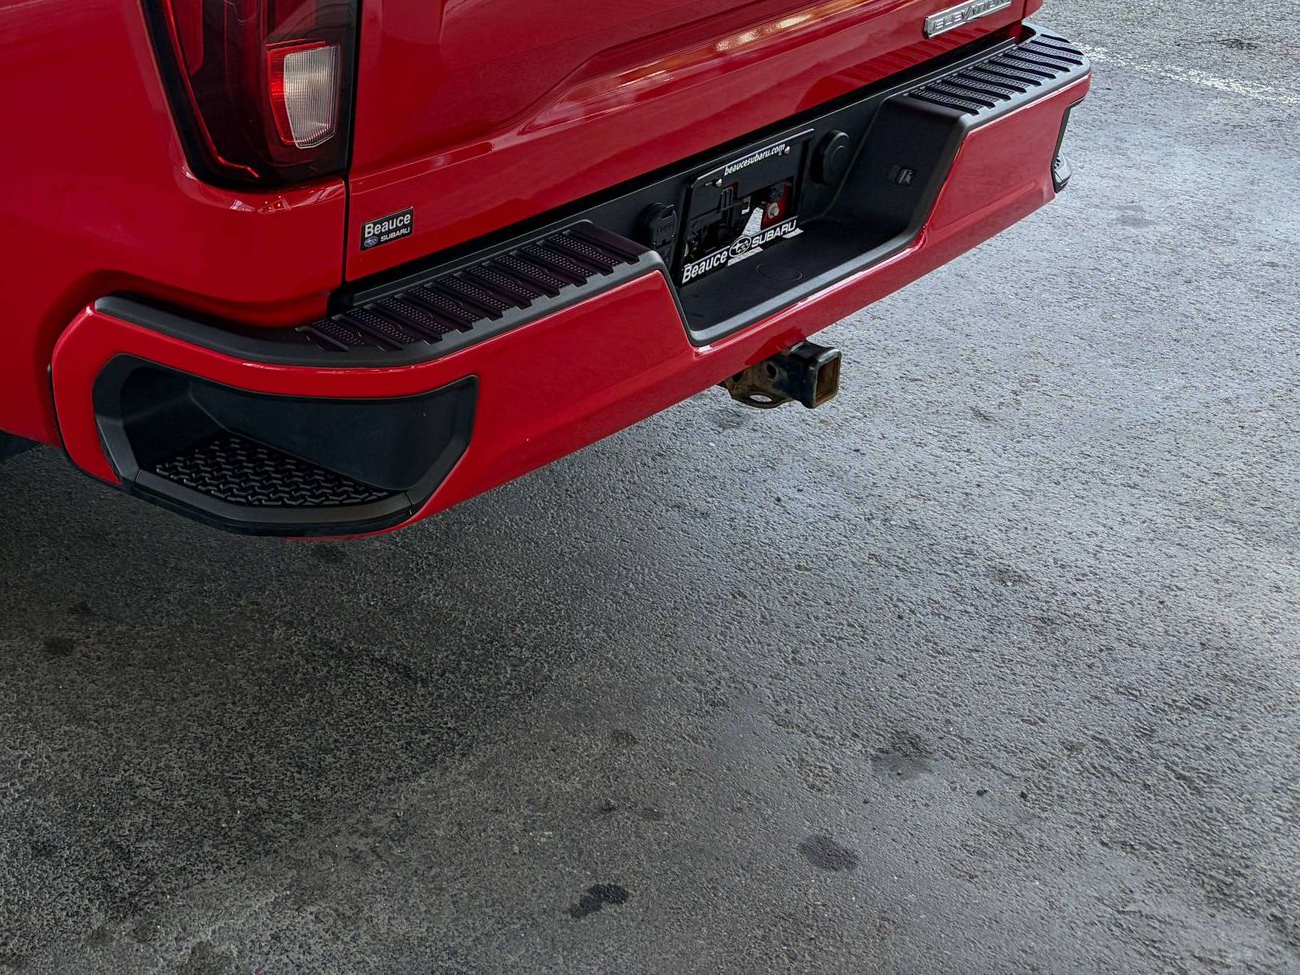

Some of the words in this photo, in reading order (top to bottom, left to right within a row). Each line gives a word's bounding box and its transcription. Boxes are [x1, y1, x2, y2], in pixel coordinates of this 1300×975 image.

[723, 142, 786, 177] beaucesubaru.com
[364, 213, 412, 239] Beauce
[380, 226, 411, 242] SUBARU
[681, 250, 729, 284] Beauce
[751, 220, 798, 248] SUBARU
